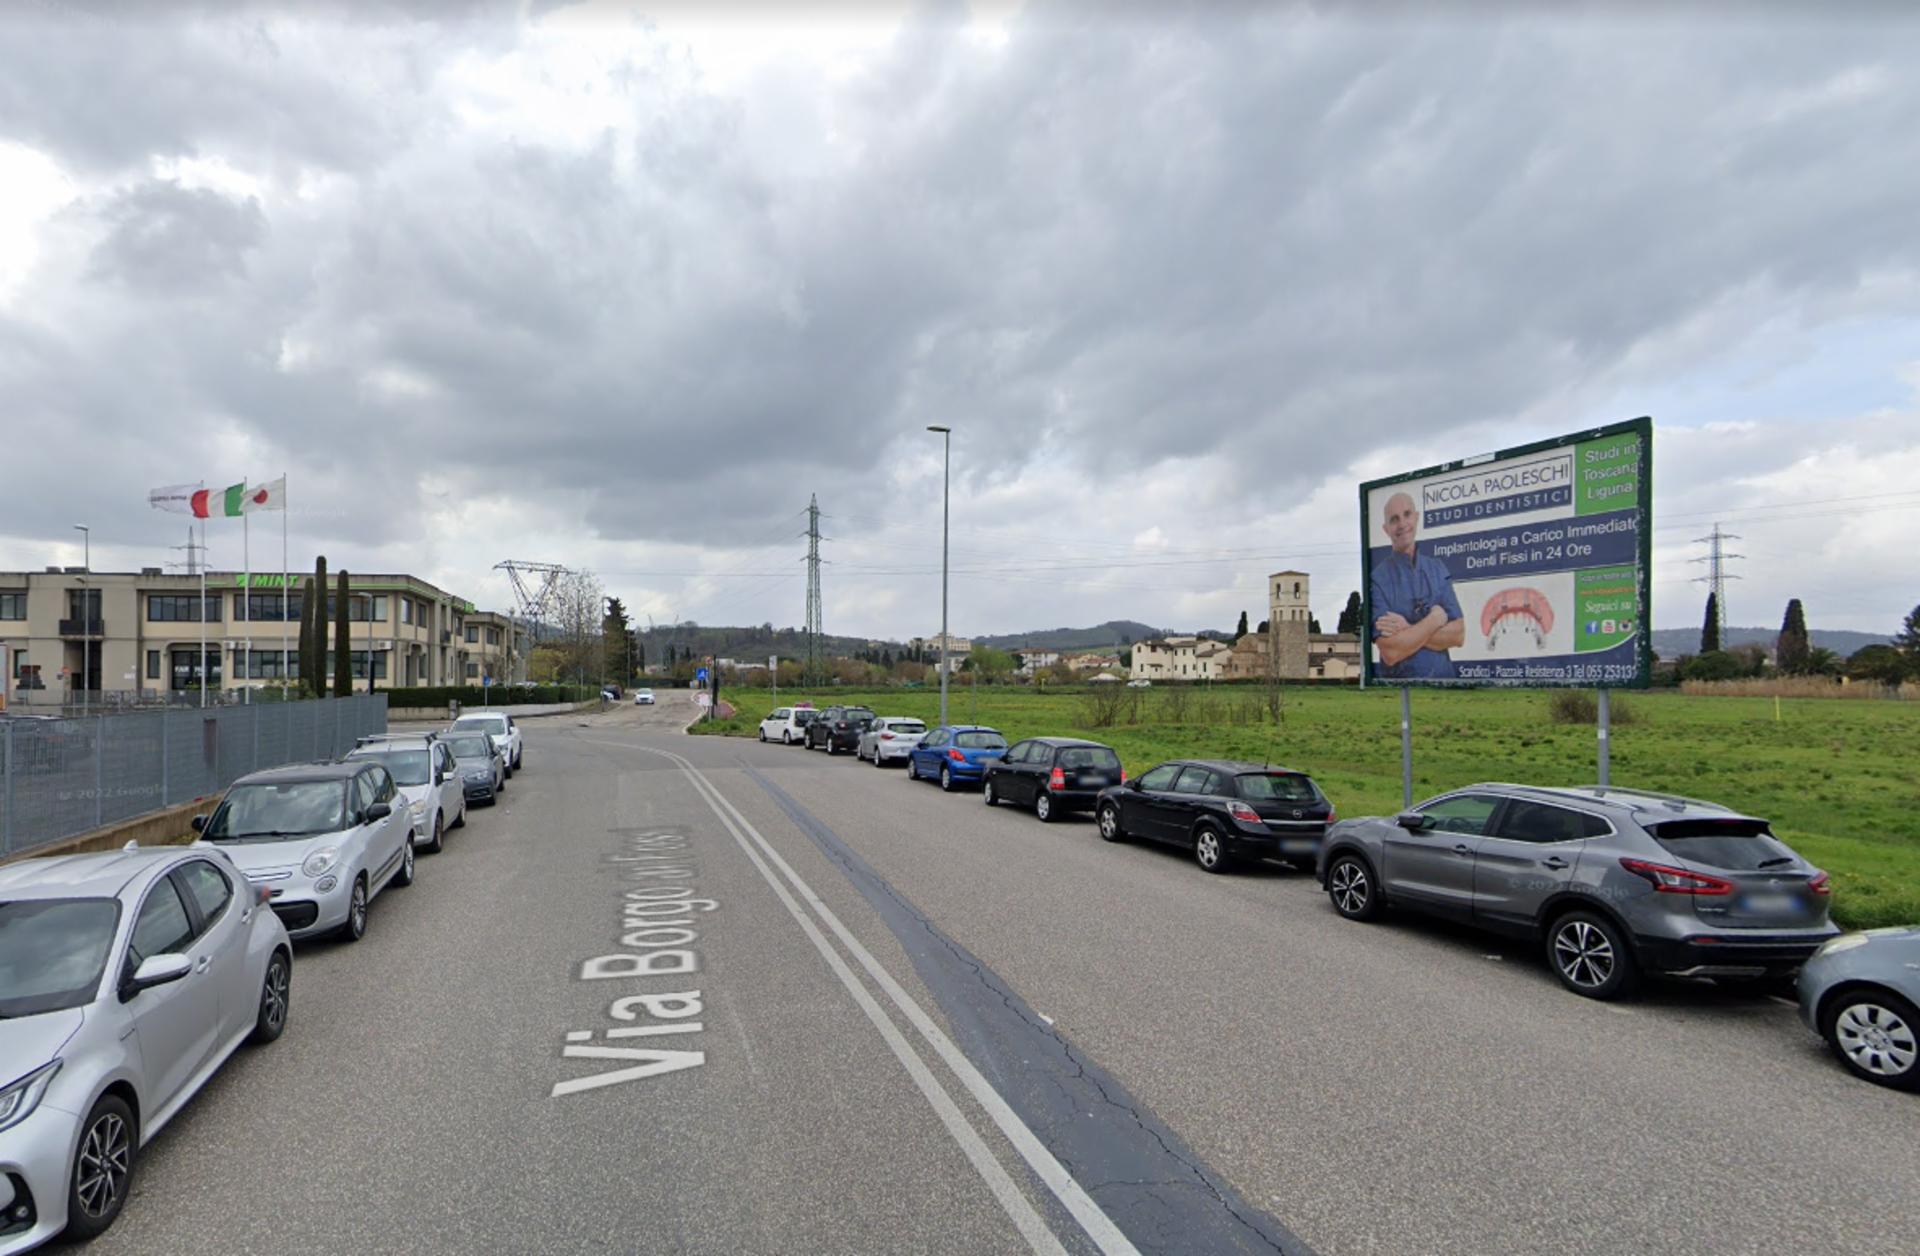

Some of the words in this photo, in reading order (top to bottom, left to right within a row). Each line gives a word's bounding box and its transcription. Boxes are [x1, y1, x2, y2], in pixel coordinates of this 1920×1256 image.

[1585, 446, 1619, 463] Studi
[1426, 483, 1479, 504] NICOLA
[1484, 463, 1569, 494] PAOLESCHI
[1427, 510, 1469, 524] STUDI
[1475, 490, 1569, 515] DENTISTICI
[1433, 536, 1507, 557] Implantologia
[1510, 536, 1519, 546] a
[1521, 529, 1564, 545] Carico
[1500, 548, 1528, 565] Fissi
[1531, 548, 1543, 561] in
[1546, 546, 1562, 559] 24
[1566, 543, 1592, 557] Ore
[1573, 664, 1585, 677] Tel
